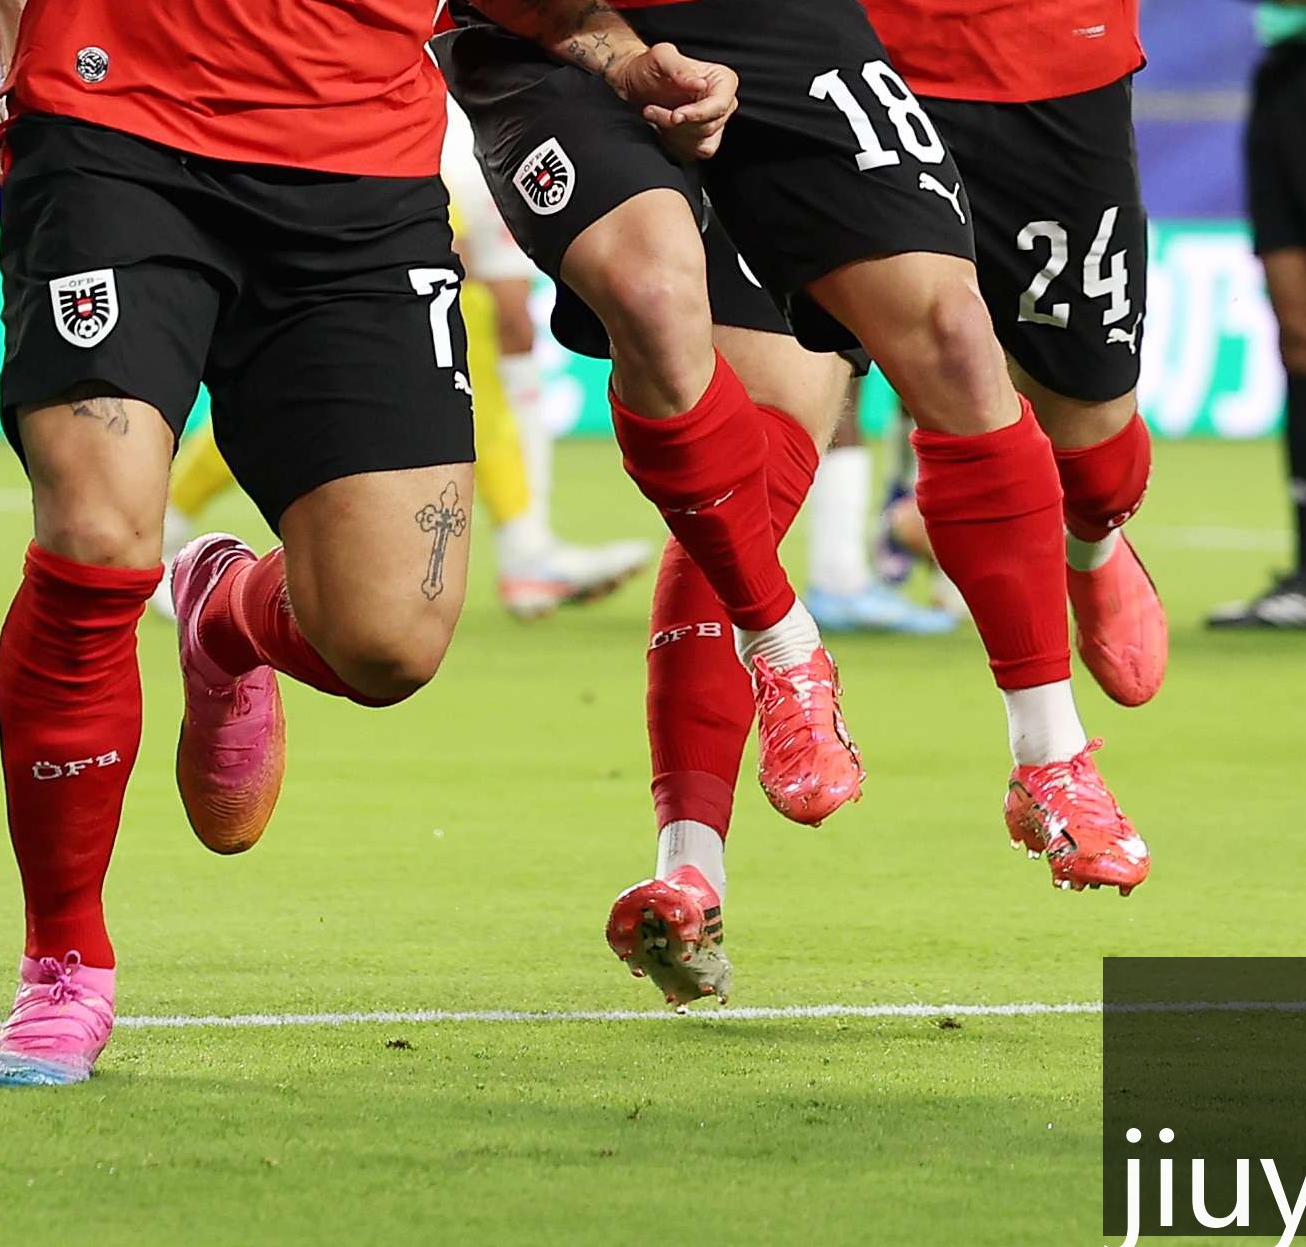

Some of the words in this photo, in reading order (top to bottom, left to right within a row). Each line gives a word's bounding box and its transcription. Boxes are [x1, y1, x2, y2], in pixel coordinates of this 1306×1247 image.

[808, 60, 946, 171] 18
[407, 267, 463, 369] 7
[1016, 206, 1132, 329] 24
[31, 749, 122, 781] ÖFB
